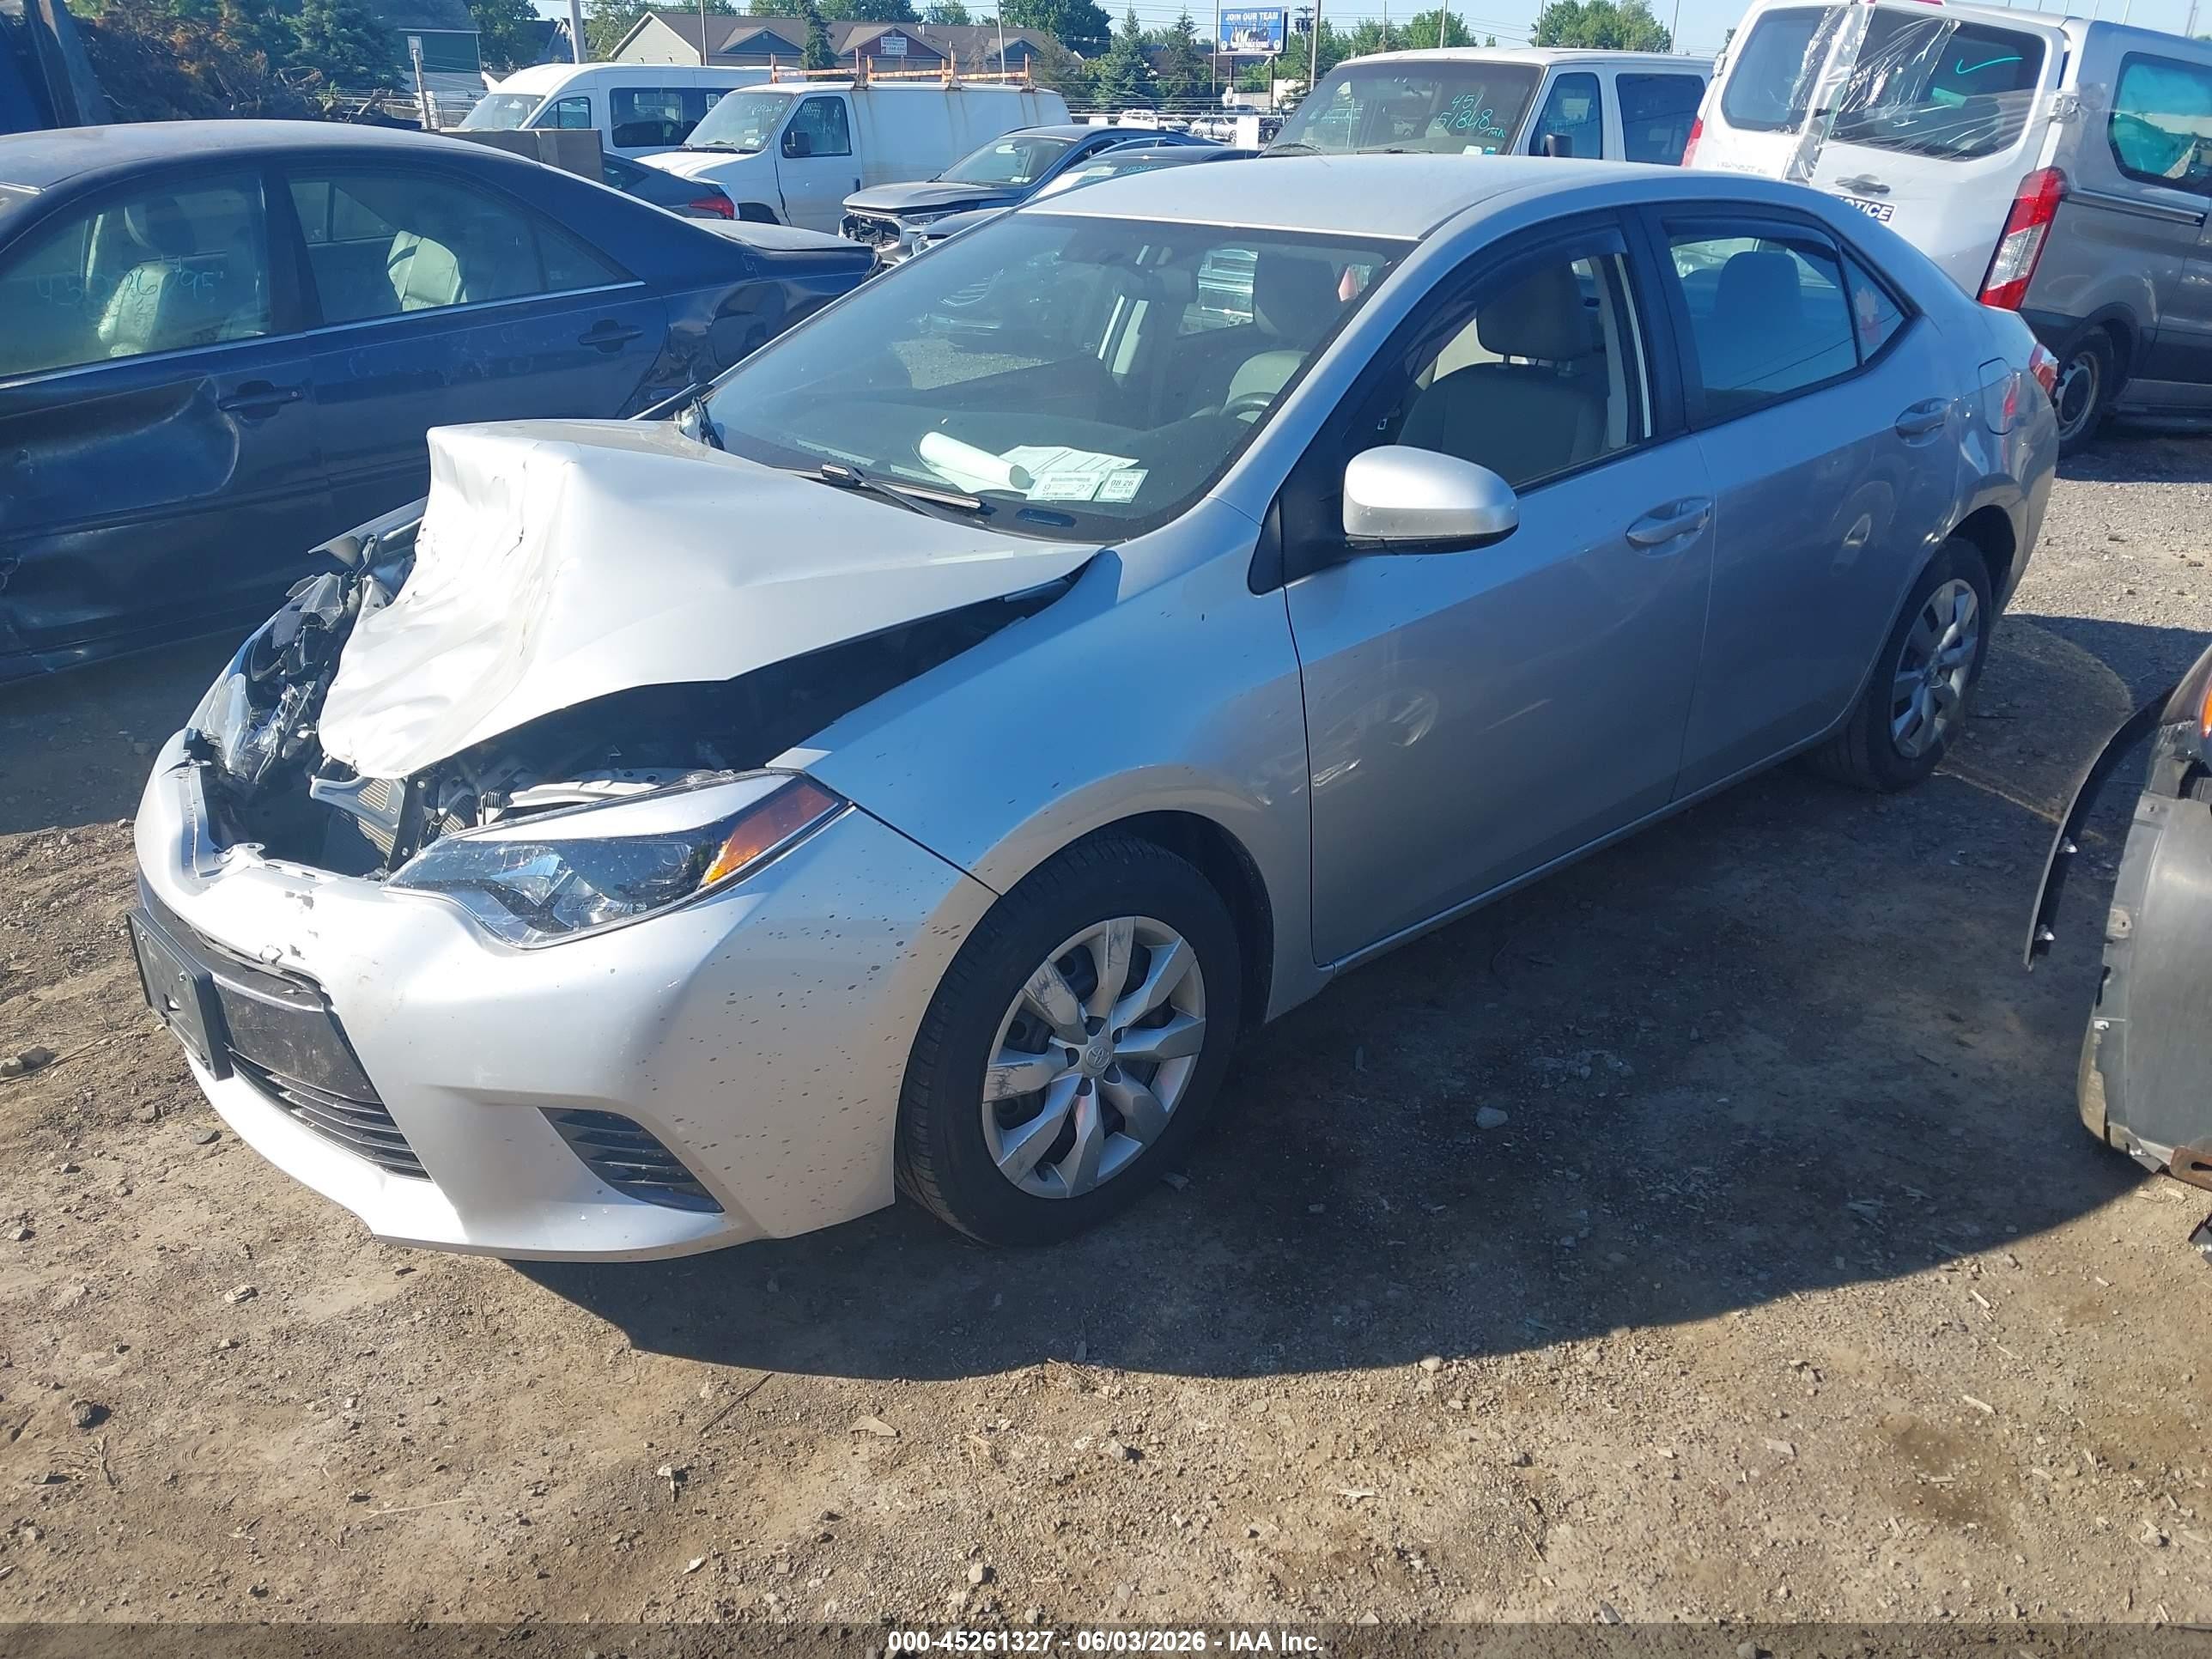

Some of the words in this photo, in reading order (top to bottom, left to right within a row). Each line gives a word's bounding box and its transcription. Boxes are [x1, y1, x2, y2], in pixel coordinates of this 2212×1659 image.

[1225, 13, 1242, 21] JOIN
[1259, 11, 1279, 20] TEAM
[1435, 109, 1493, 130] 51848
[1839, 198, 1893, 220] TICE
